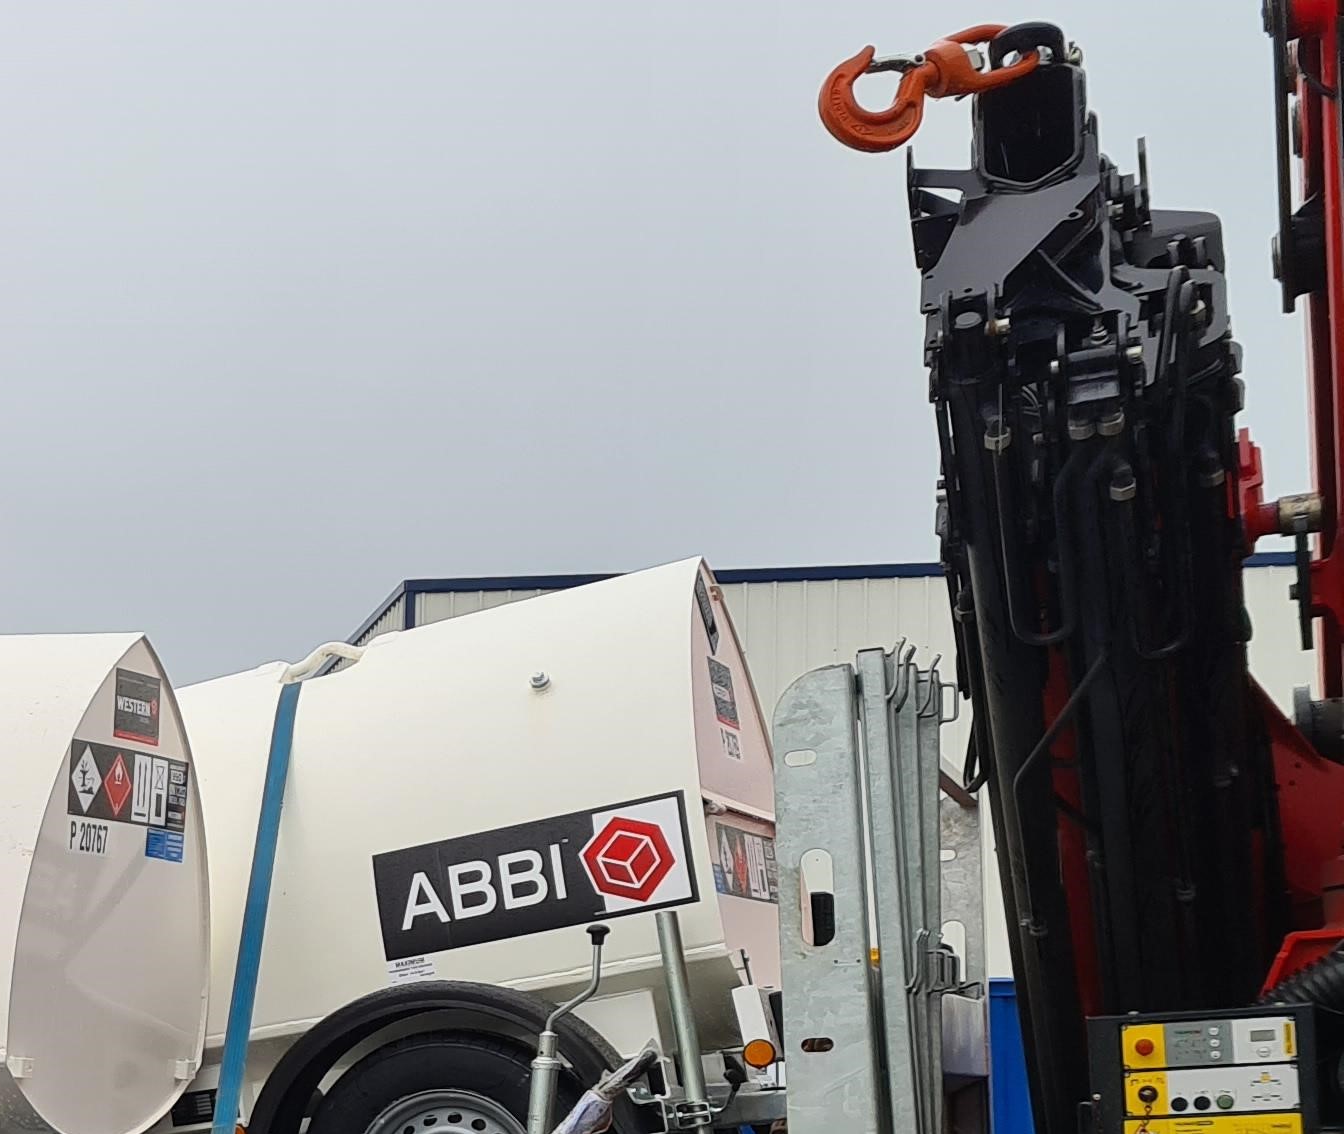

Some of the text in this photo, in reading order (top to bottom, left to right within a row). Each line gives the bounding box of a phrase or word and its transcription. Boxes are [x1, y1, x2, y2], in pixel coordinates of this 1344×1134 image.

[116, 695, 151, 717] WESTERN
[69, 820, 77, 850] P
[79, 822, 109, 854] 20767
[400, 842, 568, 932] ABBI
